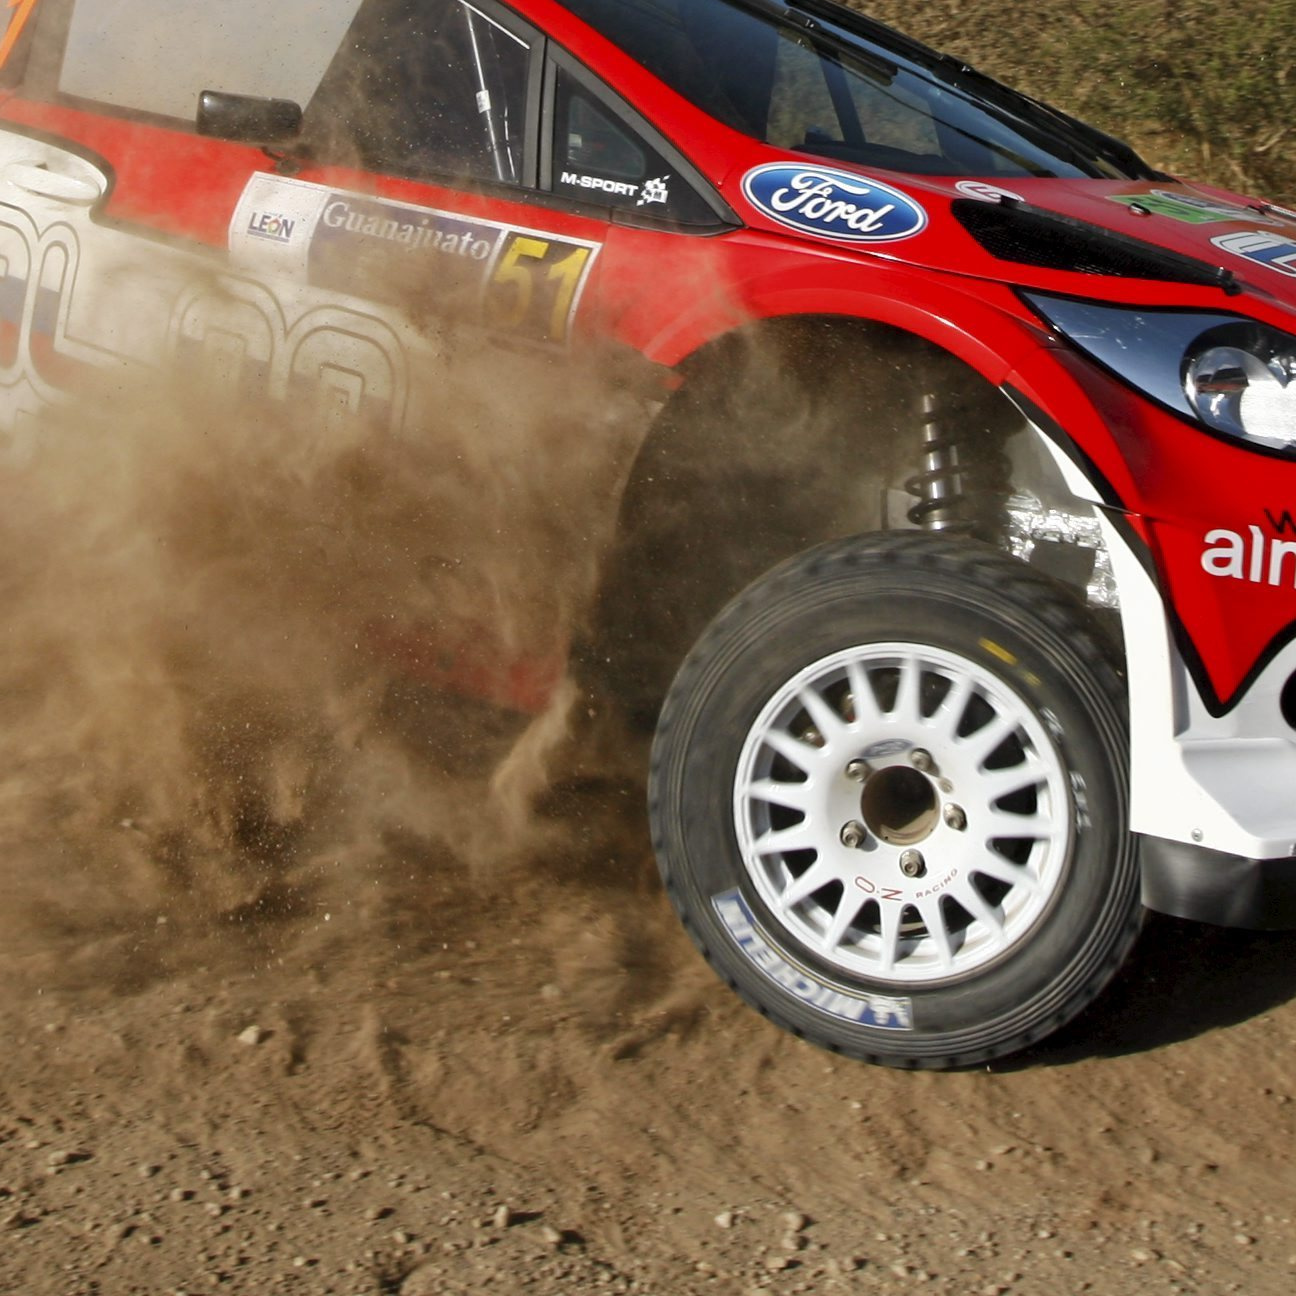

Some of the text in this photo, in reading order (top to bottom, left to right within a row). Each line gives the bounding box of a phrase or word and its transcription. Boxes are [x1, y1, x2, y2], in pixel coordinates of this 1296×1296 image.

[560, 171, 638, 196] M-SPORT
[771, 172, 895, 232] Ford
[323, 201, 491, 260] Guanajuato
[486, 237, 590, 341] 51
